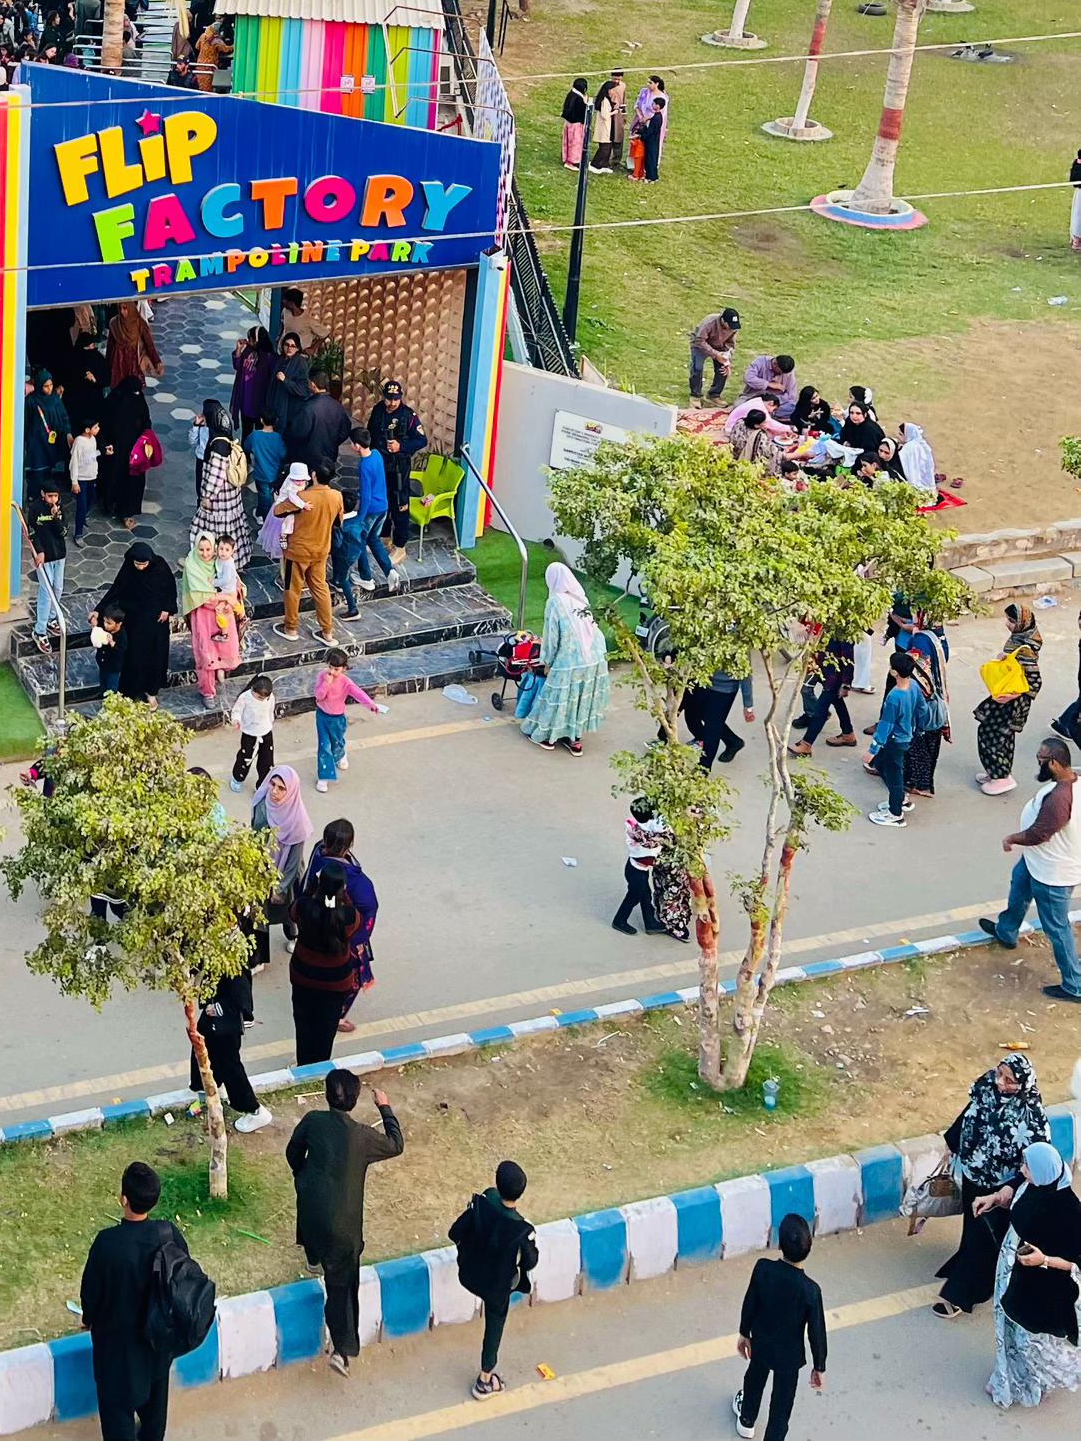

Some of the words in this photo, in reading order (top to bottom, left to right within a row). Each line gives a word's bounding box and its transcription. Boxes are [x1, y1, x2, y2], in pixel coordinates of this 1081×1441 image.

[92, 174, 473, 264] FACTORY
[129, 239, 343, 293] TRAMPOLINE
[349, 238, 434, 264] PARK
